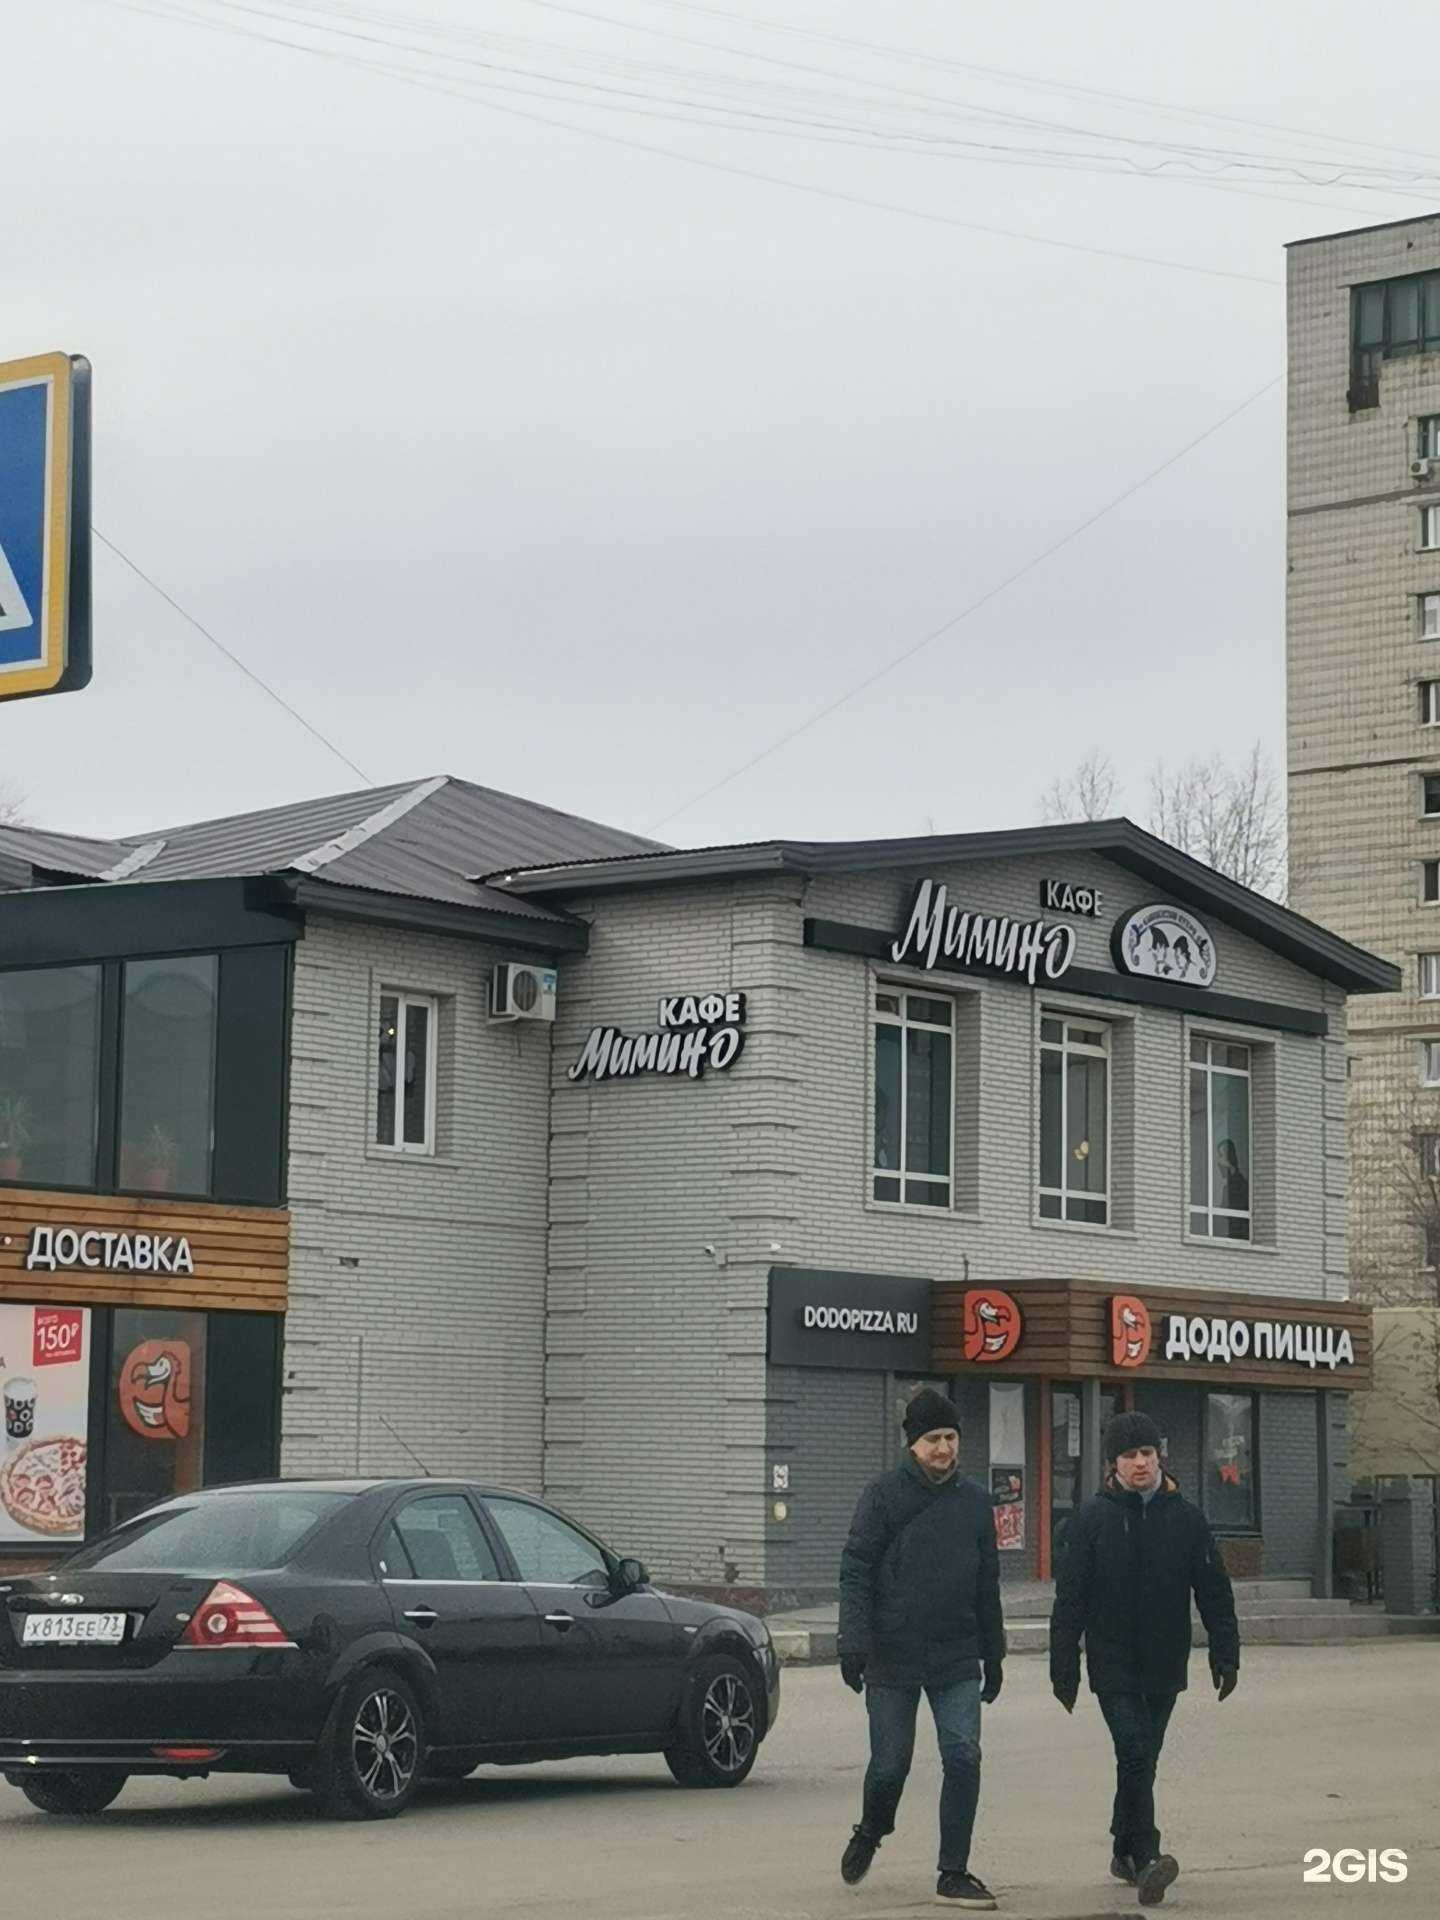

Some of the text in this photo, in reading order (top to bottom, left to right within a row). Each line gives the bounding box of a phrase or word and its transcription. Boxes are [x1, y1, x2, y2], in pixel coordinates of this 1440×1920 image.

[1046, 879, 1104, 917] КАФЕ
[891, 878, 1077, 985] Мимино
[659, 993, 741, 1027] КАФЕ
[567, 1026, 741, 1080] Мимино
[26, 1226, 195, 1274] ДОСТАВКА
[1165, 1315, 1355, 1371] ДОДО ПИЦЦА
